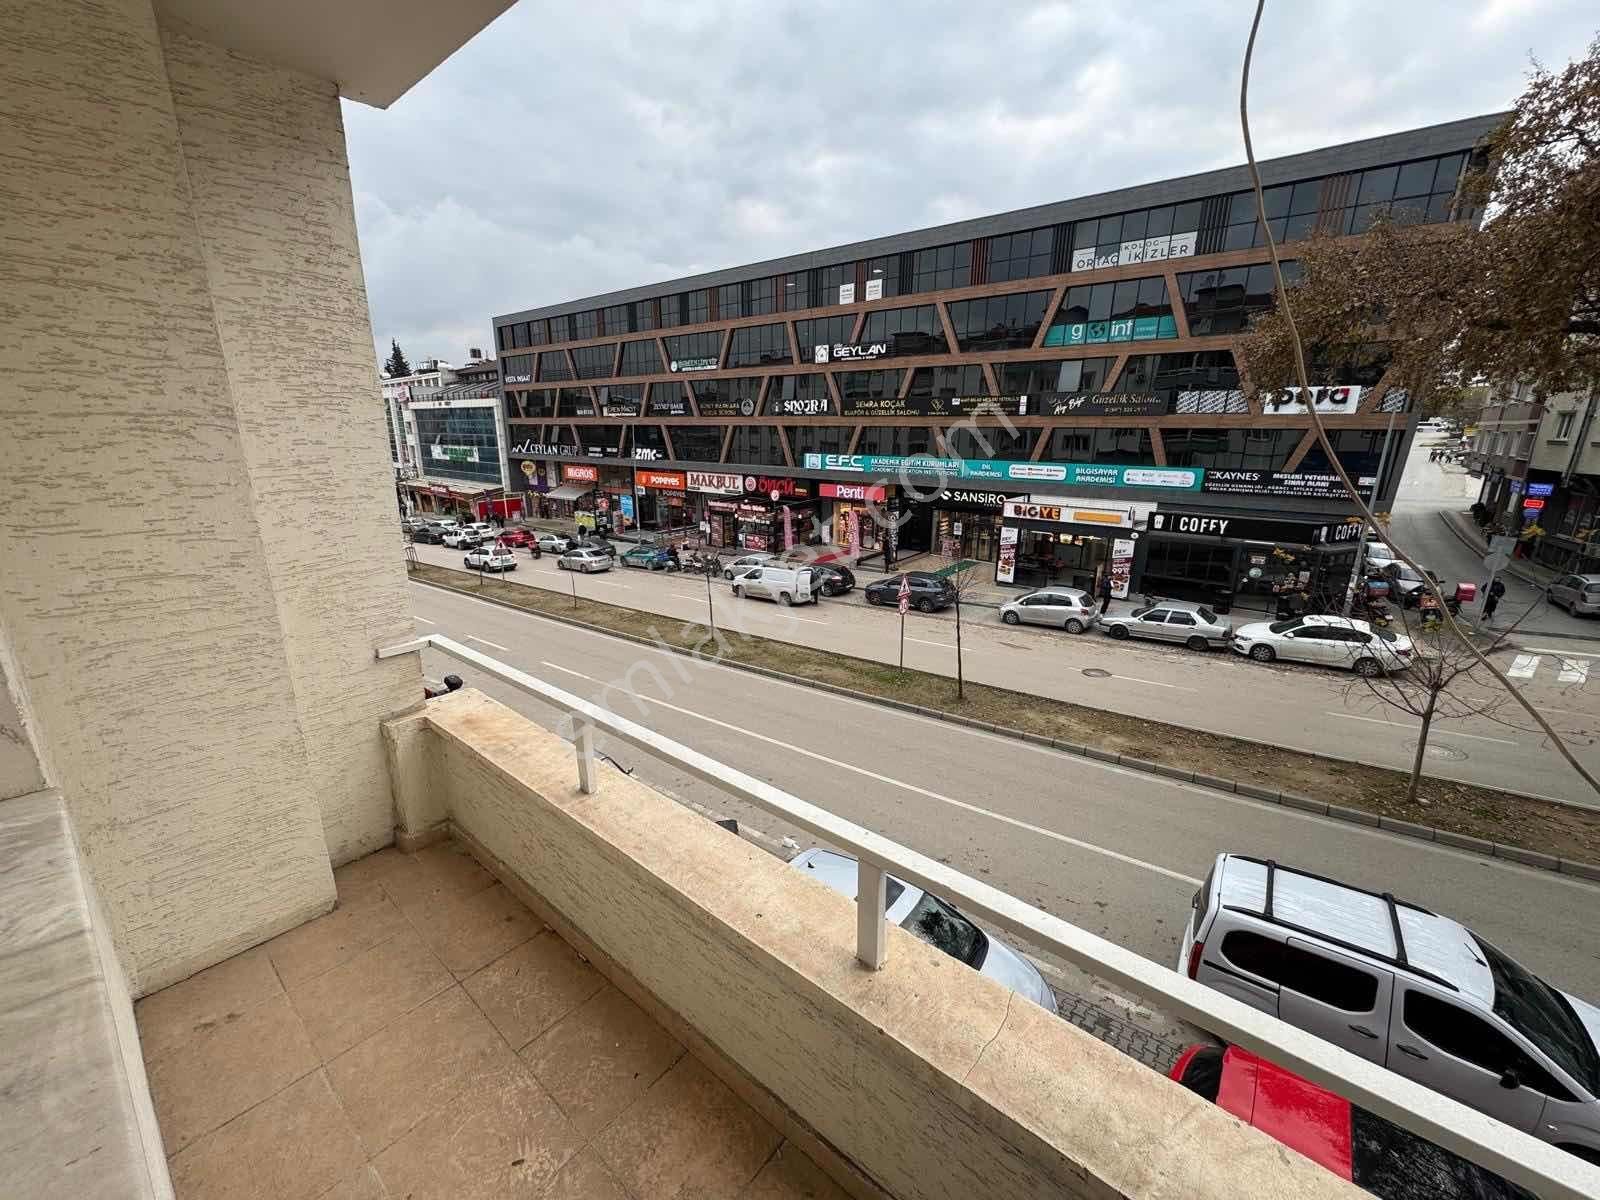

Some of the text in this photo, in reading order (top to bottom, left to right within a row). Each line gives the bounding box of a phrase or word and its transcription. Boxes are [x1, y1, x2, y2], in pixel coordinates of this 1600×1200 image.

[833, 344, 887, 357] GEYLAN
[530, 444, 557, 455] CEYLAN
[651, 475, 680, 486] POPEYES
[690, 473, 739, 490] MAKBUL
[1215, 471, 1259, 481] KAYNES
[836, 485, 865, 500] Penti
[1179, 516, 1230, 535] COFFY
[1335, 525, 1363, 541] COFFY
